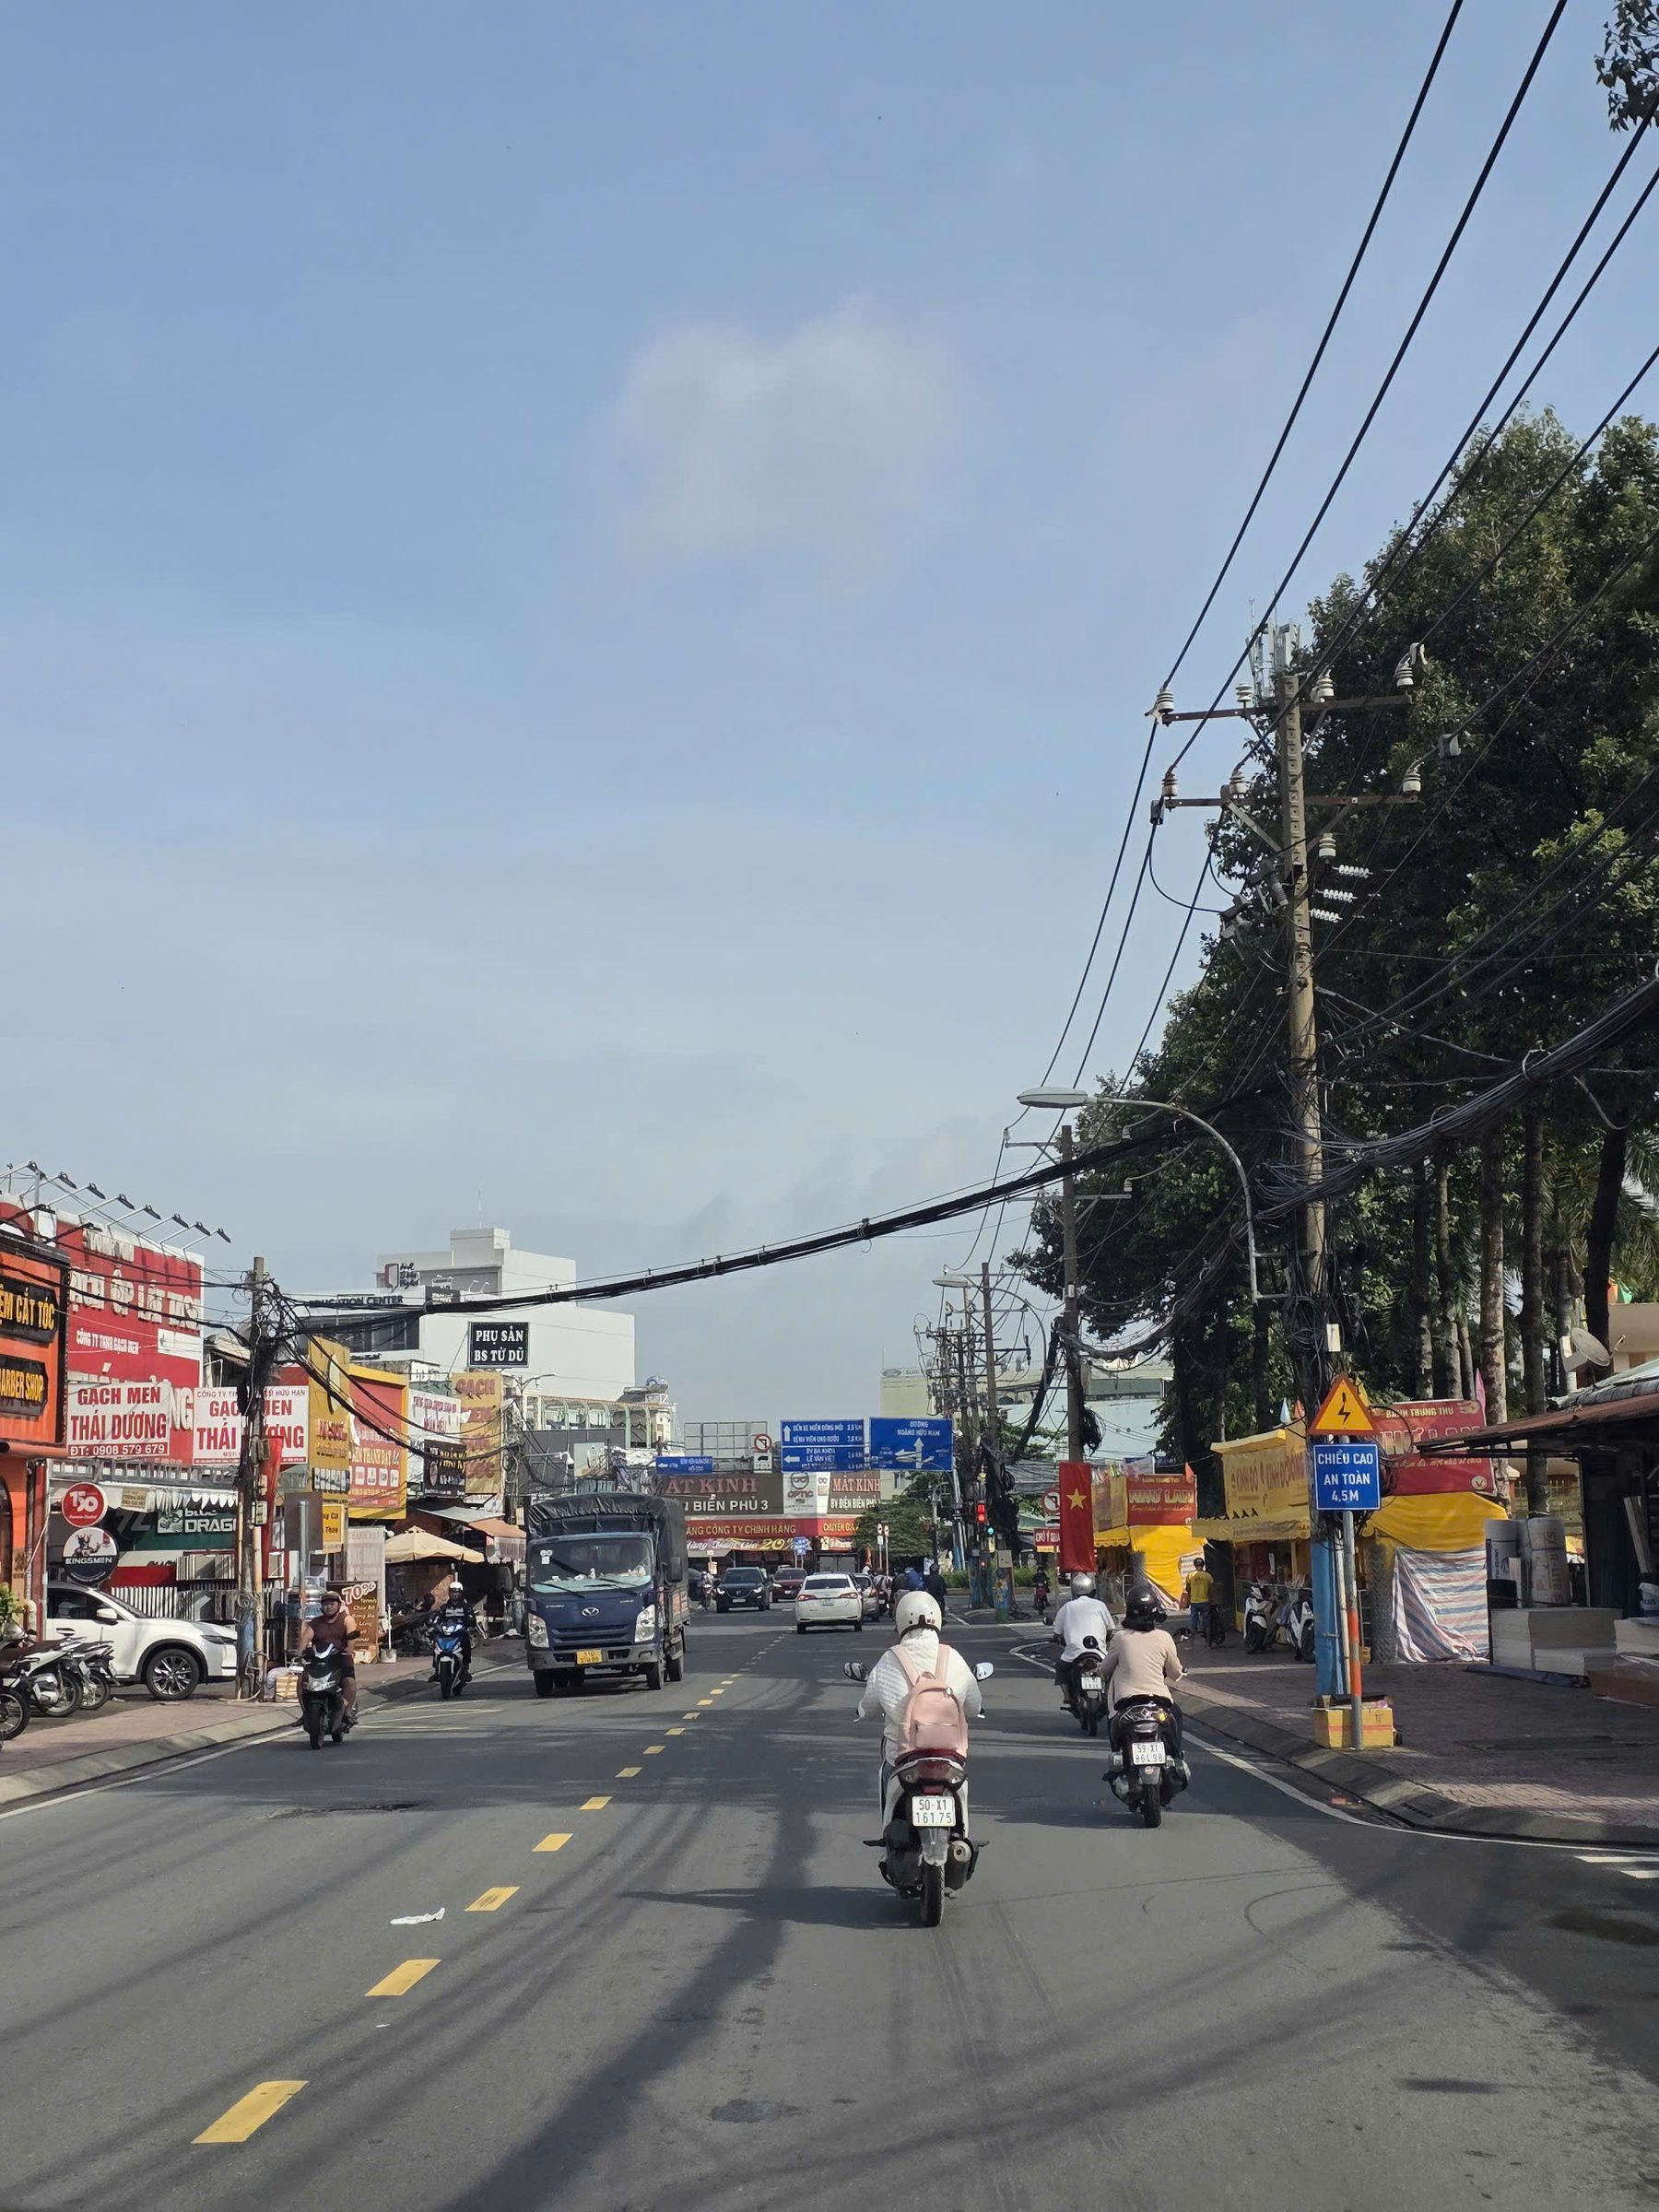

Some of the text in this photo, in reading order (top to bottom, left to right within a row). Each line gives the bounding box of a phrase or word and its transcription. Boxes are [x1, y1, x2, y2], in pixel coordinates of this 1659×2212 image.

[16, 1286, 35, 1325] CẮT
[38, 1297, 55, 1330] TÓC
[366, 1295, 404, 1305] CENTER
[476, 1325, 524, 1346] PHỤ SẢN
[474, 1346, 524, 1362] BS TỪ DŨ
[0, 1368, 25, 1400] ARBER
[26, 1372, 44, 1402] SHOP
[77, 1387, 160, 1407] GẠCH MEN
[209, 1401, 240, 1420] GẠC
[1409, 1408, 1437, 1418] TRUNG
[1438, 1407, 1453, 1417] THU
[71, 1409, 167, 1441] THÁI DƯƠNG
[197, 1422, 237, 1450] THÁI
[70, 1443, 165, 1456] ĐT: 0908 579 679
[1318, 1449, 1373, 1465] CHIỀU CAO
[855, 1475, 880, 1492] KÍNH
[1324, 1470, 1371, 1486] AN TOÀN
[730, 1495, 758, 1512] PHỦ
[760, 1500, 769, 1511] 3
[1128, 1488, 1194, 1504] NHƯ LAN
[184, 1519, 236, 1533] DRAG
[733, 1526, 744, 1535] TY
[342, 1581, 377, 1605] 70%
